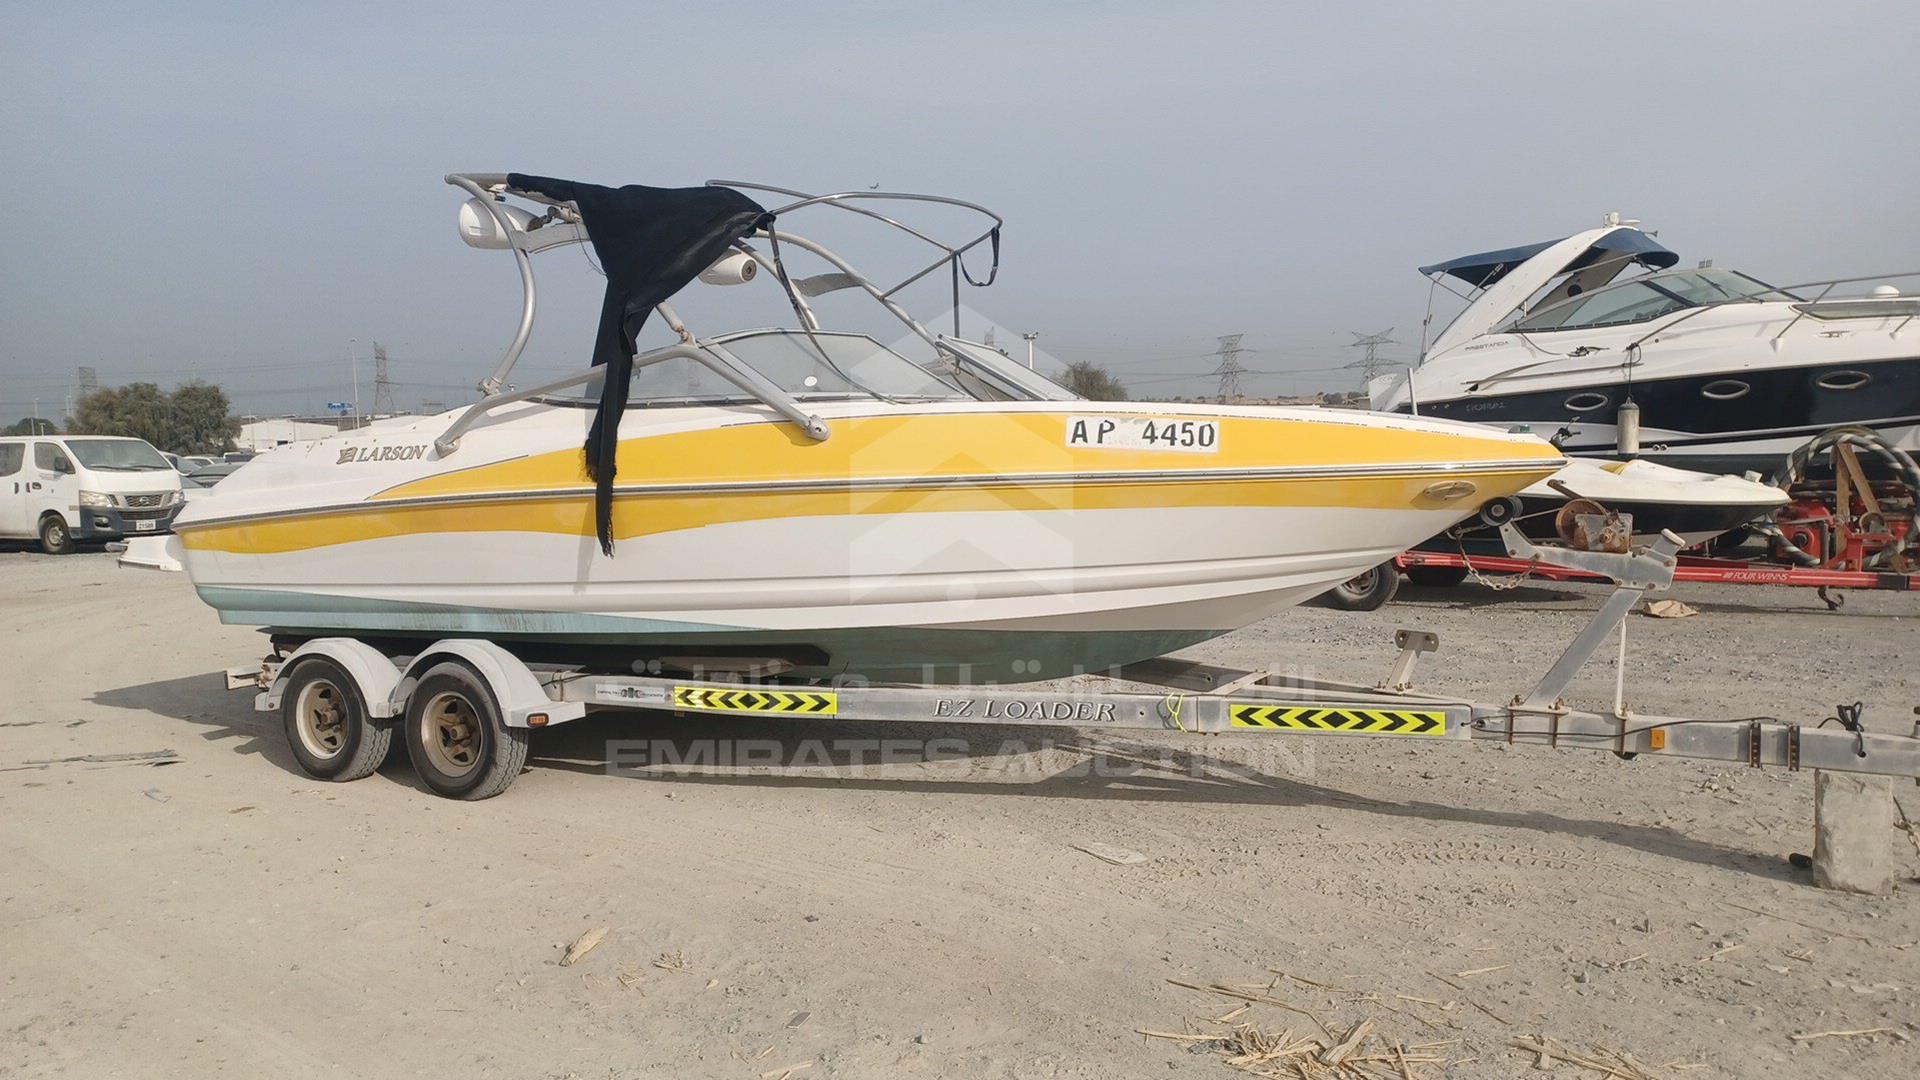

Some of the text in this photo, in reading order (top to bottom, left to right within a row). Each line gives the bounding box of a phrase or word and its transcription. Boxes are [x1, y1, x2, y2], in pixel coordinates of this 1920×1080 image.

[1142, 420, 1216, 447] 4450
[356, 445, 428, 462] LARSON
[1732, 571, 1789, 581] FOUR WINNS
[933, 699, 1117, 722] EZ LOADER
